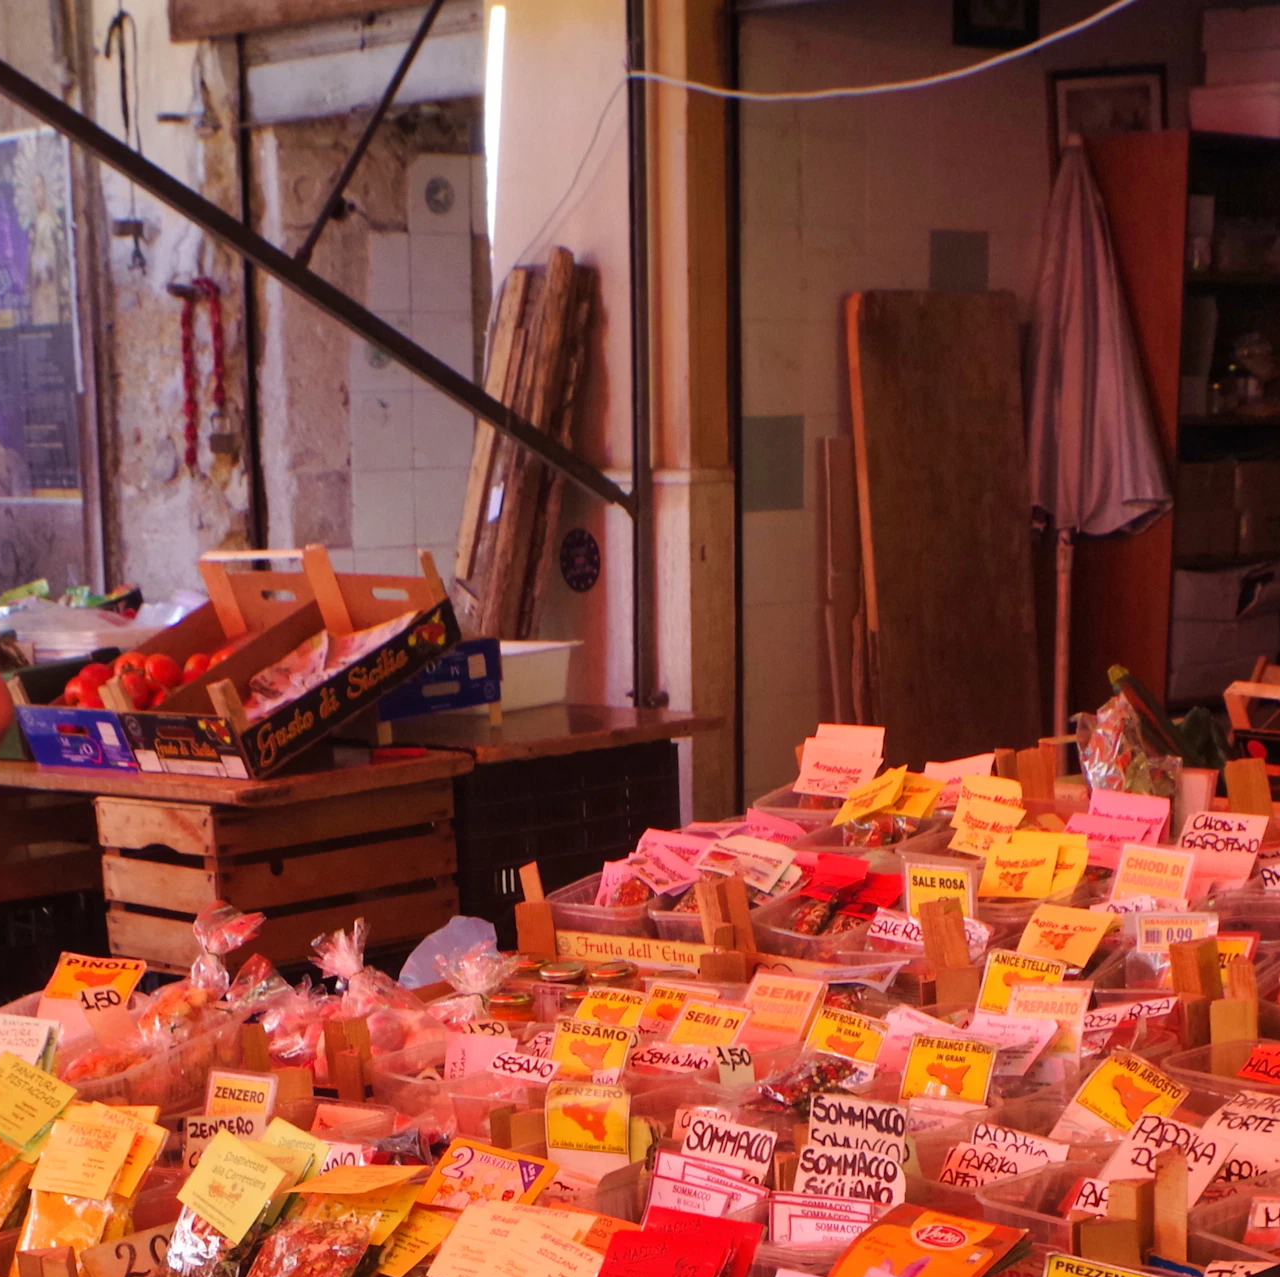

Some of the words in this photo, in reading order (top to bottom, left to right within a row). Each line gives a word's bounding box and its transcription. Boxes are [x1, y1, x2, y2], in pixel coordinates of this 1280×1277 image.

[256, 708, 315, 767] Gusto
[319, 688, 341, 720] di
[347, 648, 408, 699] Sicilia
[1182, 836, 1260, 853] GAROFANO
[1125, 856, 1169, 874] CHIODI
[1171, 864, 1185, 875] DI
[912, 875, 938, 888] SALE
[939, 876, 966, 891] ROSA
[1032, 917, 1058, 930] Aglio
[1072, 924, 1097, 933] Olio
[576, 938, 623, 958] Frutta
[66, 957, 140, 971] PINOLI
[994, 953, 1019, 968] ANICE
[1020, 956, 1061, 975] STELLATO
[80, 990, 120, 1011] 1,50
[590, 989, 608, 999] SEMI
[619, 991, 644, 1006] ANICE
[755, 985, 810, 1002] SEMI
[1015, 999, 1079, 1015] PREPARATO
[686, 1011, 719, 1026] SEMI
[721, 1017, 739, 1029] DI
[821, 1009, 838, 1022] PEPE
[838, 1013, 856, 1026] ROSA
[561, 1022, 628, 1041] SESAMO
[844, 1029, 861, 1039] GRANI
[917, 1037, 936, 1048] PEPE
[936, 1039, 963, 1051] BIANCO
[971, 1044, 992, 1055] NERO
[493, 1054, 553, 1078] SESAMO
[936, 1052, 943, 1060] IN
[944, 1053, 966, 1063] GRANI
[11, 1061, 58, 1092] PANATURA
[1139, 1066, 1181, 1099] ARROSTO
[4, 1072, 61, 1109] PISTACCHIO
[214, 1086, 265, 1103] ZENZERO
[554, 1086, 624, 1098] ZENZERO
[813, 1097, 905, 1136] SOMMACCO
[70, 1124, 117, 1141] PANATURA
[686, 1118, 773, 1163] SOMMACCO
[73, 1138, 114, 1152] LIMONE
[223, 1151, 268, 1173] Spaghettata
[442, 1147, 474, 1179] 2
[800, 1150, 898, 1183] SOMMACCO
[212, 1164, 227, 1175] alla
[228, 1169, 267, 1191] Carrettiera
[672, 1184, 711, 1202] SOMMACCO
[815, 1223, 863, 1234] SOMMACCO
[540, 1232, 594, 1264] SPAGHETTATA
[537, 1247, 577, 1272] SICILIANA
